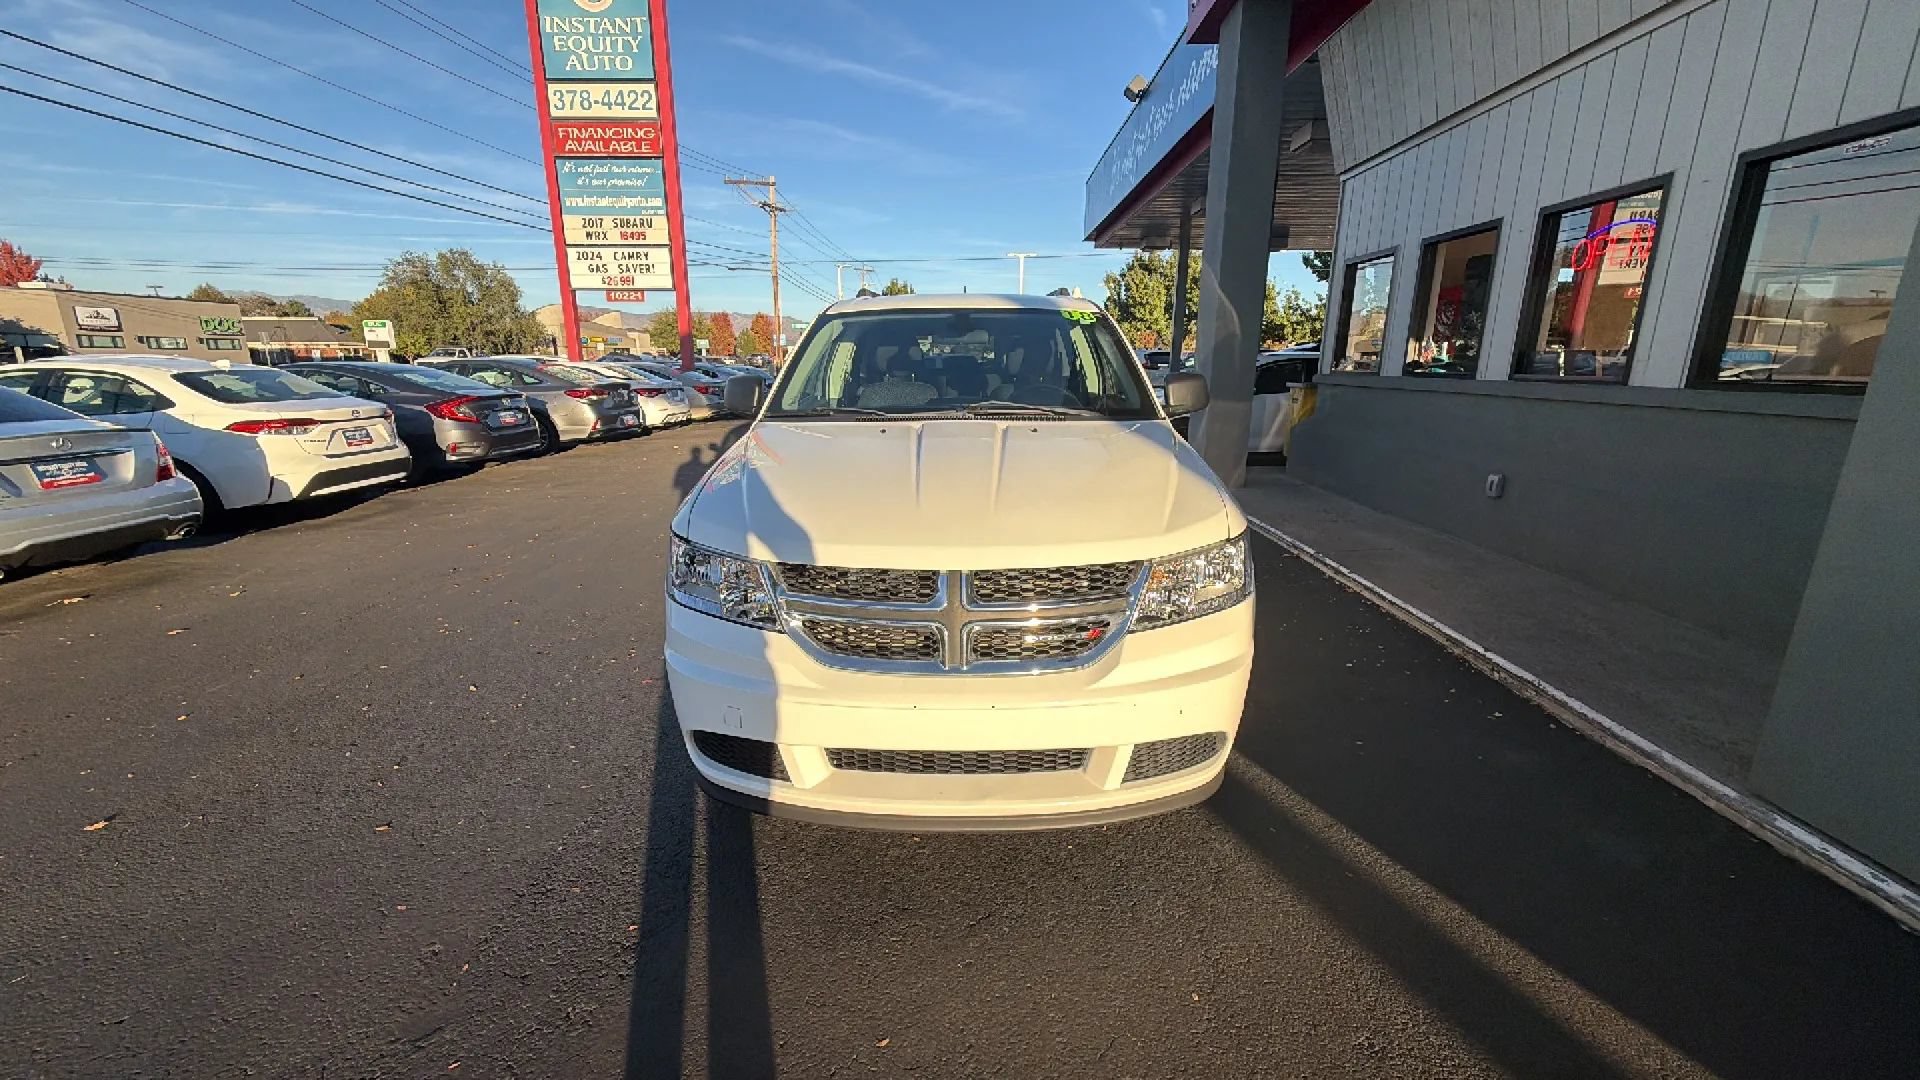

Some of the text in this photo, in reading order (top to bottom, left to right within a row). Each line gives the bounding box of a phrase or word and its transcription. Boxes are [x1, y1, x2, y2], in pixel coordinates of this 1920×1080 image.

[544, 15, 647, 34] INSTANT
[552, 35, 643, 55] EQUITY
[565, 54, 633, 71] AUTO
[553, 89, 654, 111] 378-4422
[557, 127, 656, 140] FINANCING
[564, 140, 653, 153] AVAILABLE
[581, 217, 653, 229] 2017 SUBARU
[585, 230, 647, 241] WRX 16495
[575, 251, 649, 261] 2024 CAMRY
[587, 263, 656, 275] GAS SAVER!
